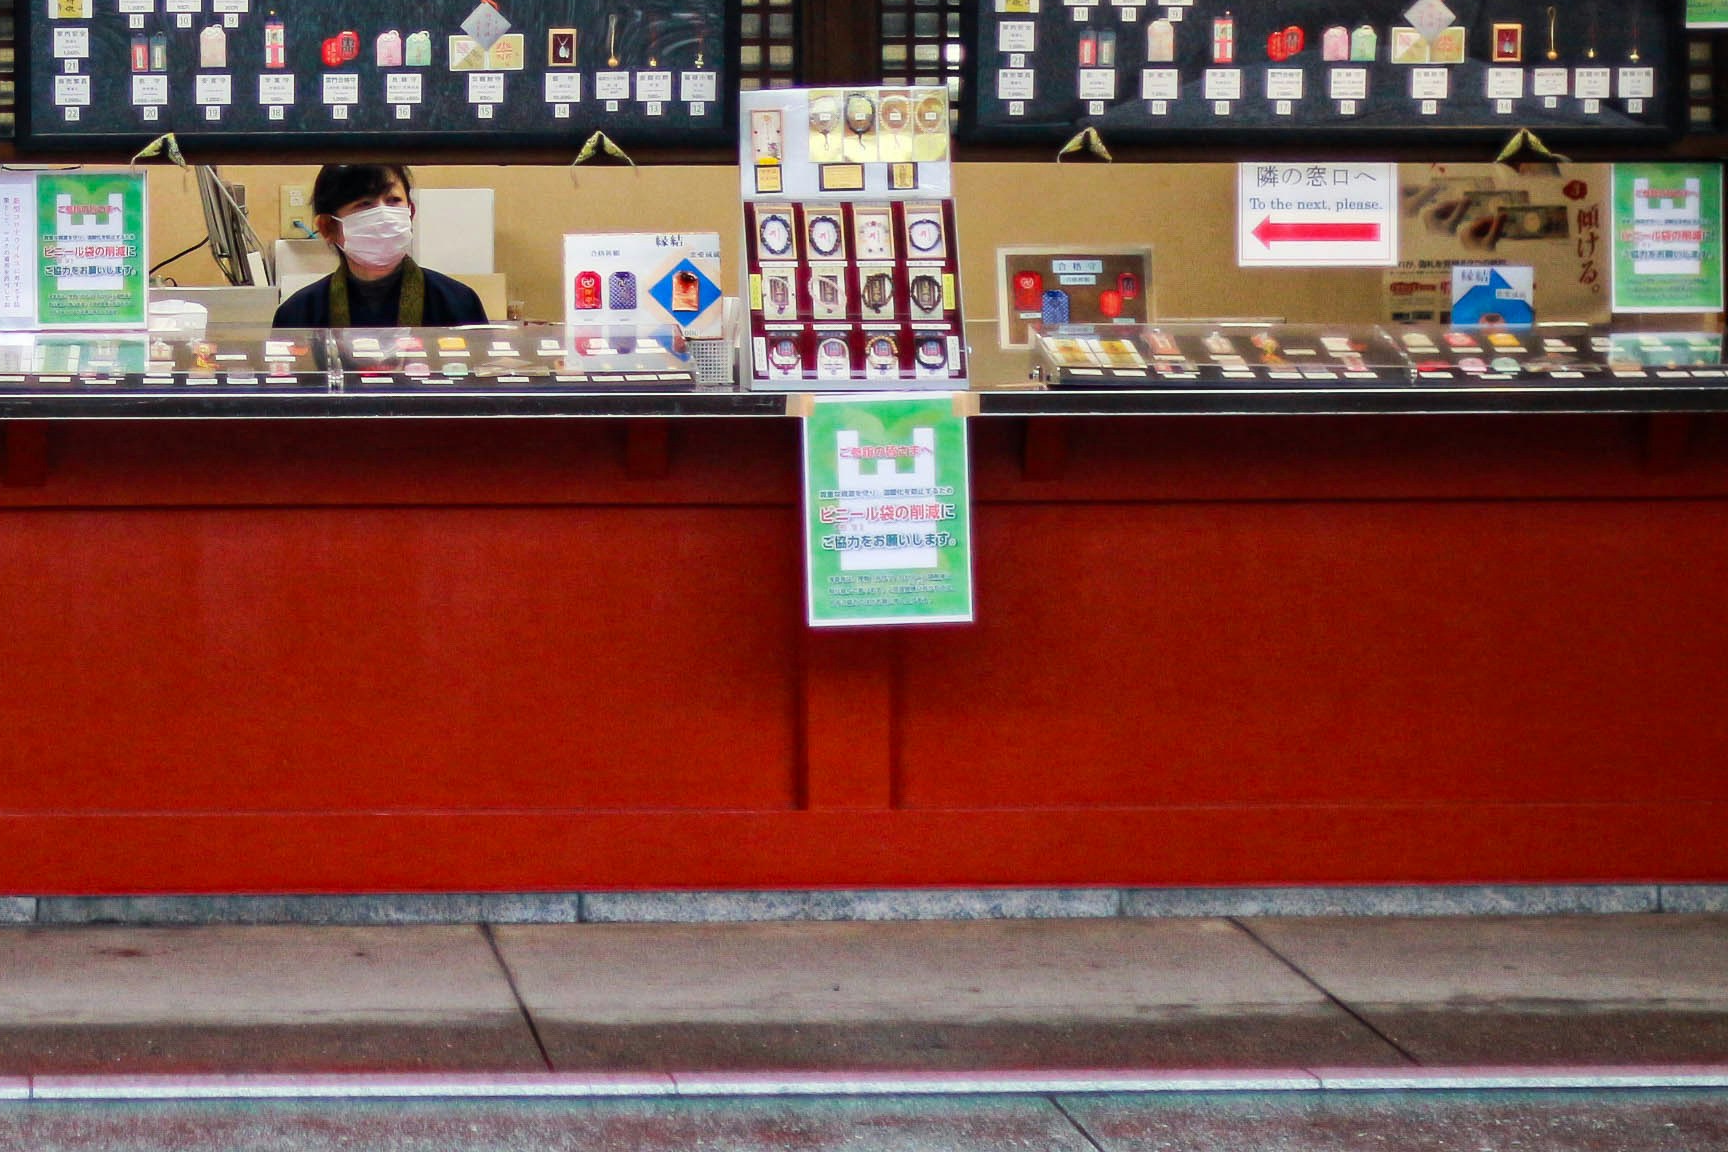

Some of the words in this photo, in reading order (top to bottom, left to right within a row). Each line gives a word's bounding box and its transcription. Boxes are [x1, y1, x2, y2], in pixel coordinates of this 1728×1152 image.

[1256, 165, 1377, 188] 隣の窓口へ
[1249, 198, 1266, 210] To
[1271, 198, 1293, 210] the
[1297, 200, 1331, 212] next,
[1336, 198, 1383, 212] please.
[819, 503, 956, 524] ビニール袋の削減に
[822, 532, 958, 551] ご協力をお願いします。
